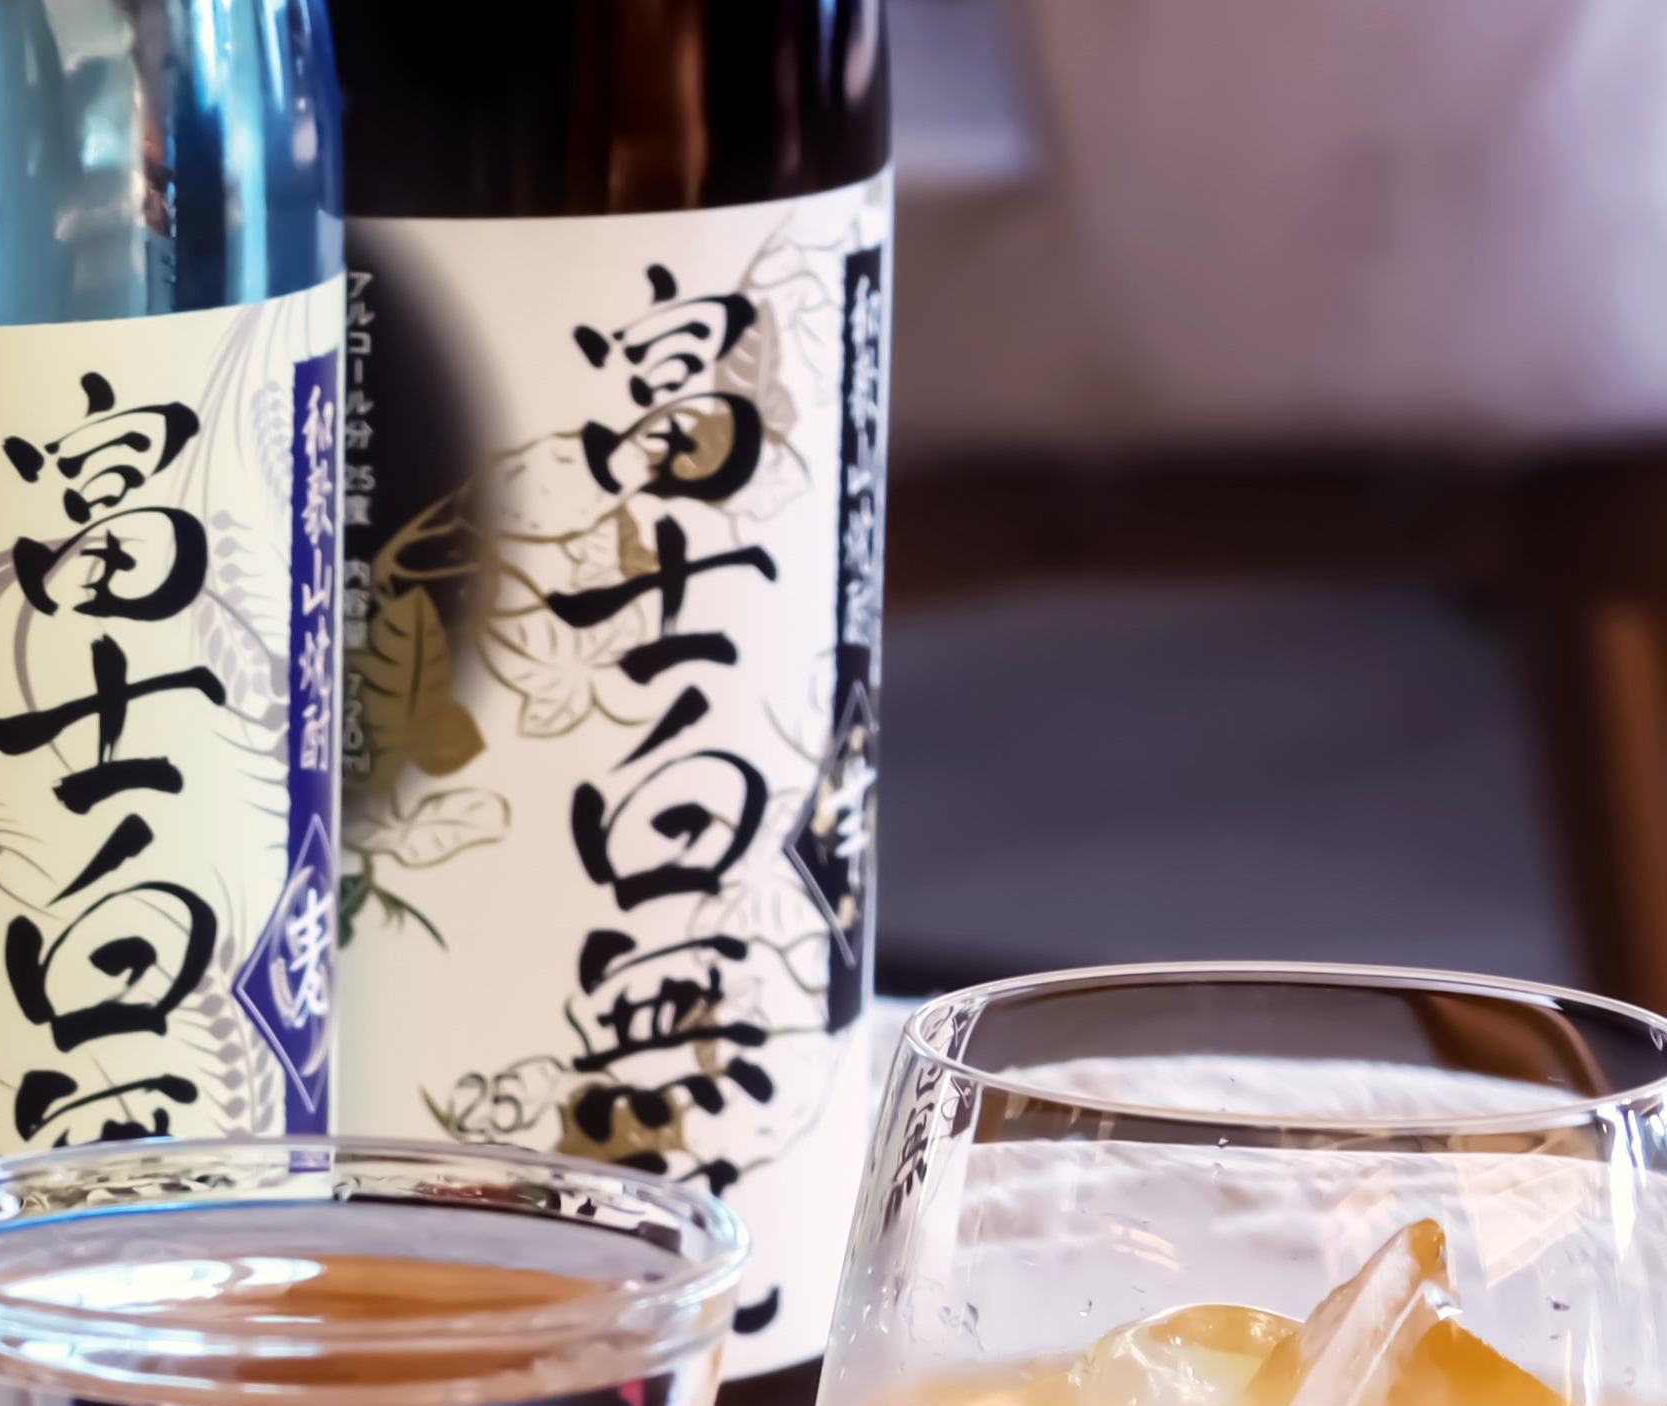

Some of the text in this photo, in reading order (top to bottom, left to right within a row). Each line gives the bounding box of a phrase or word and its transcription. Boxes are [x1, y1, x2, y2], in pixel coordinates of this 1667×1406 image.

[545, 264, 780, 1336] 富士白無
[455, 1072, 523, 1134] 25
